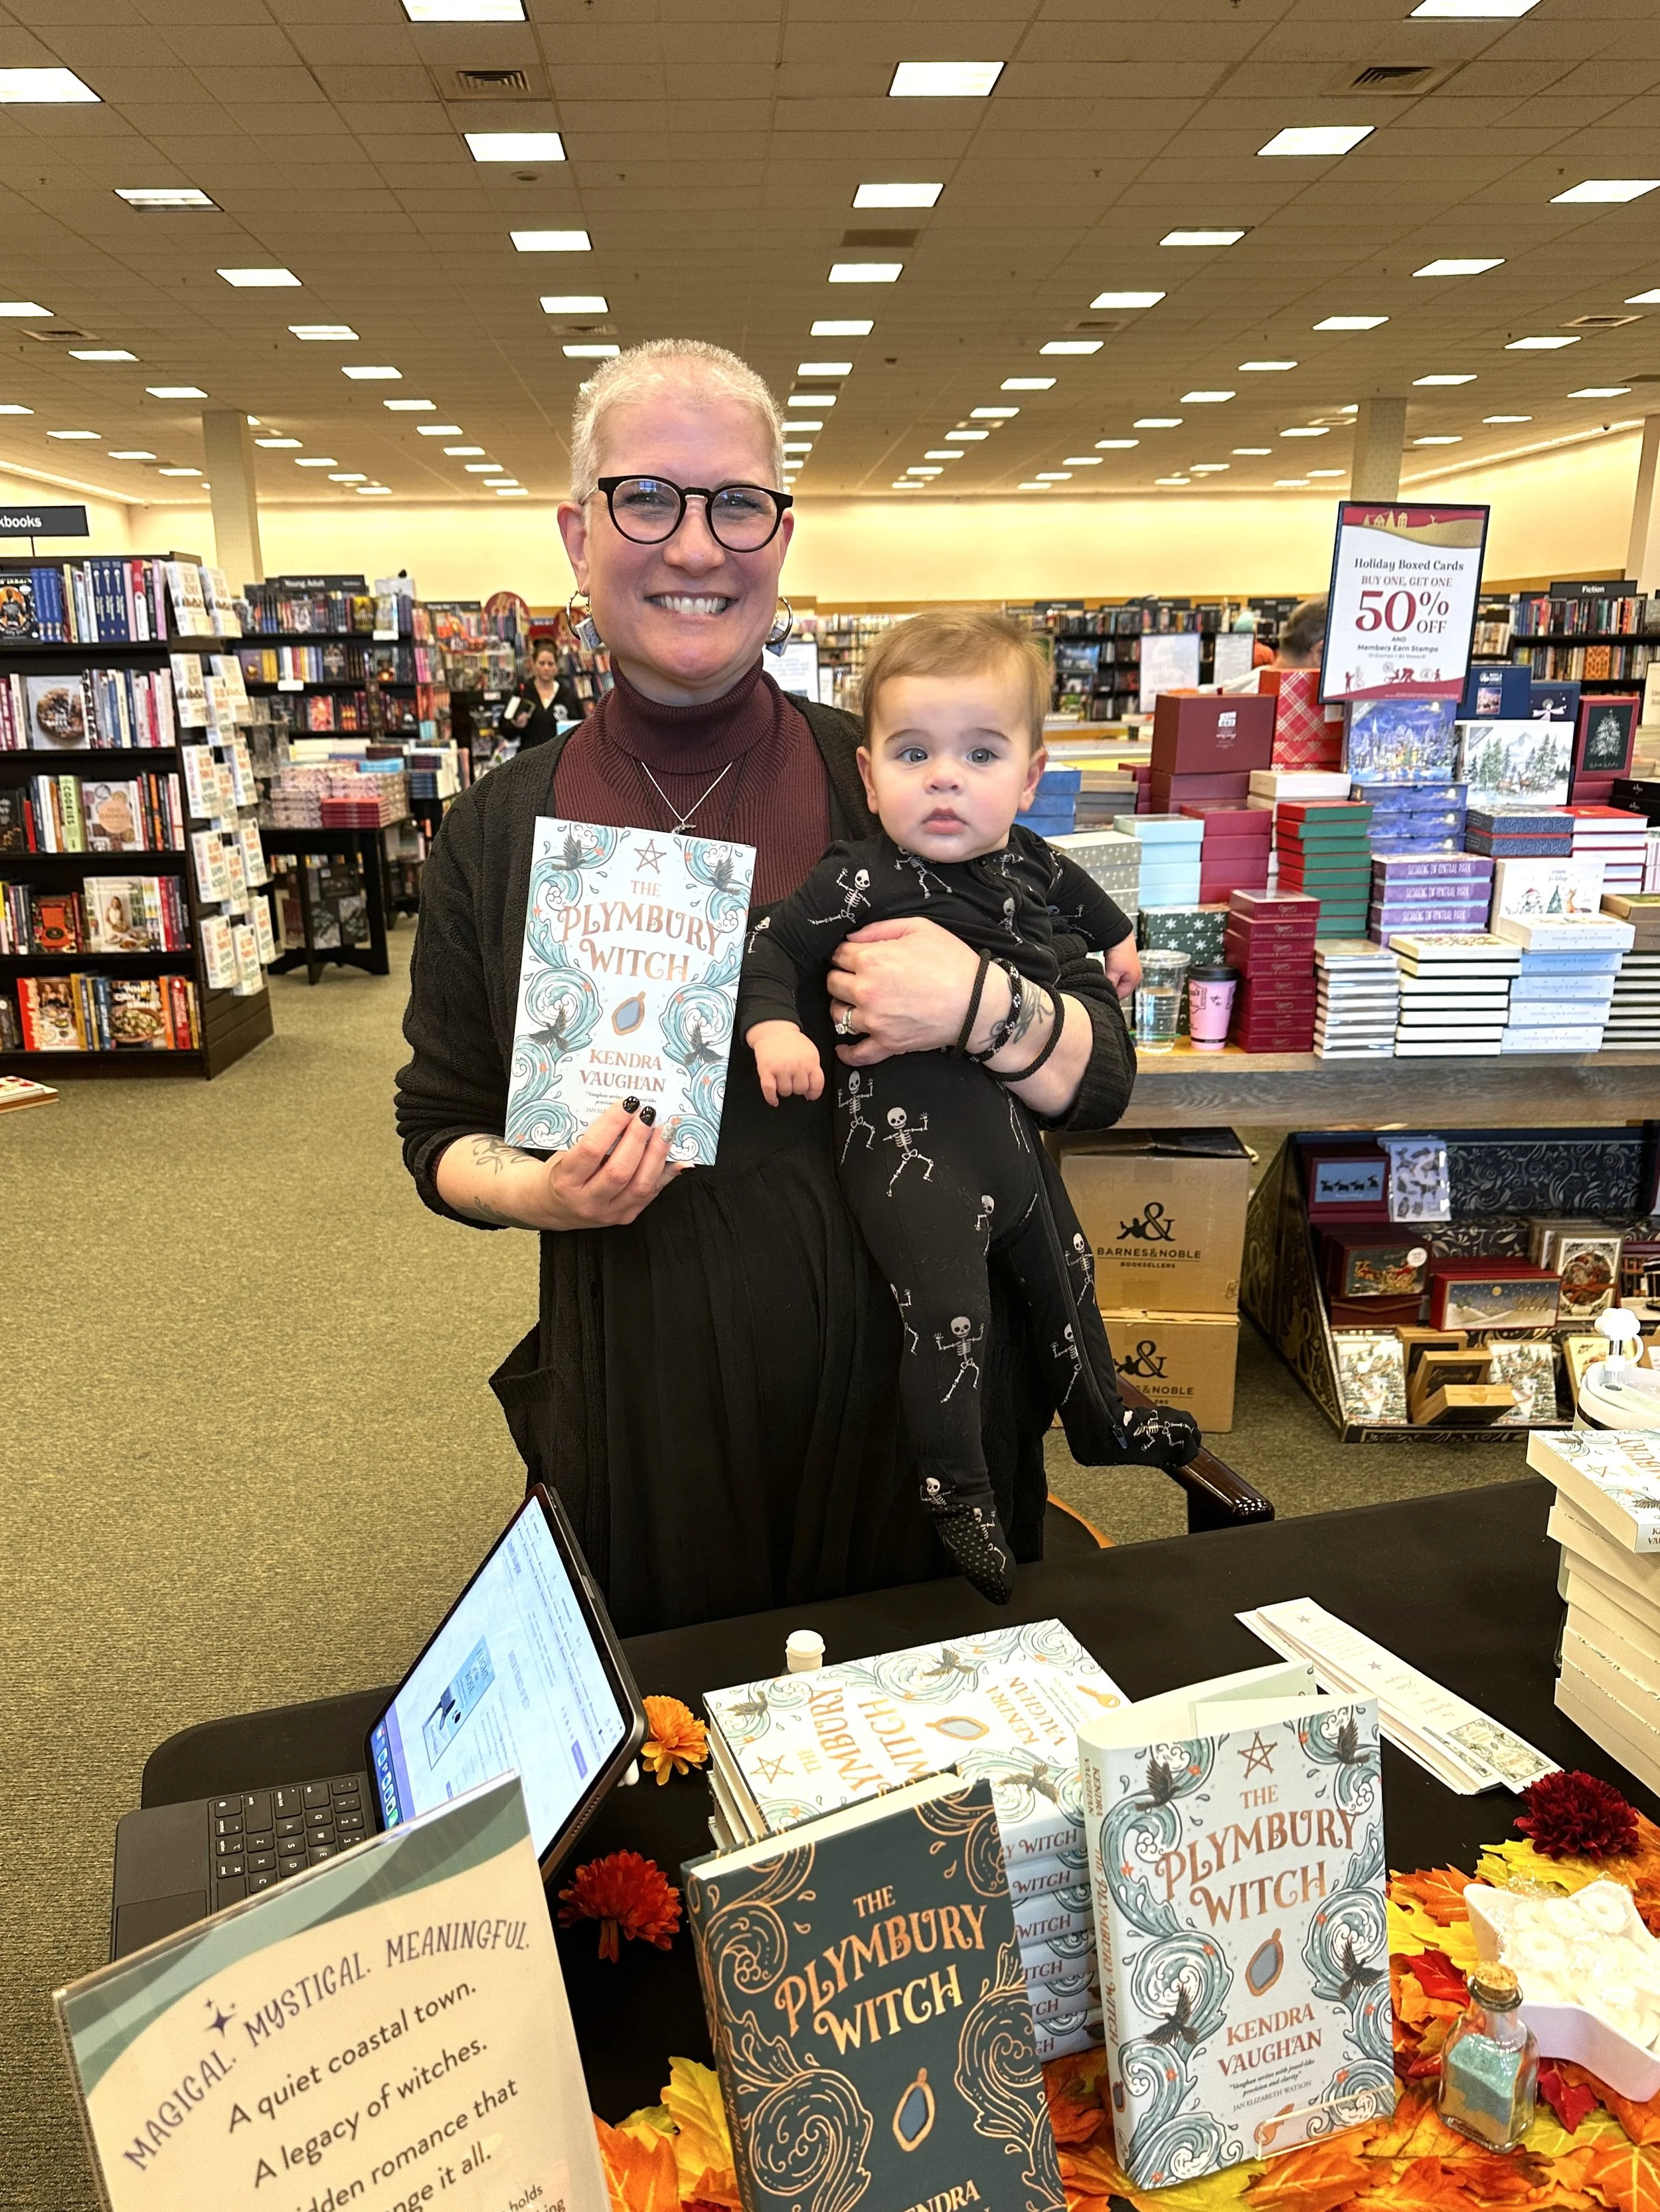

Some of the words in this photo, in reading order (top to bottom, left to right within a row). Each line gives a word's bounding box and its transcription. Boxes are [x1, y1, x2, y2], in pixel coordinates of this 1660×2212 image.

[1355, 558, 1395, 572] Holiday
[1398, 559, 1431, 570] Boxed
[1433, 560, 1464, 570] Cards
[1361, 576, 1382, 585] BUY
[1383, 576, 1407, 587] ONE,
[1409, 577, 1428, 586] GET
[1431, 578, 1452, 587] ONE
[1417, 620, 1448, 634] OFF
[1459, 863, 1471, 873] PARK
[630, 880, 661, 898] THE
[1457, 886, 1469, 896] PARK
[557, 900, 724, 956] PLYMBURY
[1453, 909, 1466, 920] PARK
[578, 938, 691, 982] WITCH
[589, 1049, 663, 1071] KENDRA
[579, 1069, 667, 1093] VAUGHAN
[476, 1648, 490, 1680] FLIGHT
[985, 1685, 1040, 1745] KENDRA
[1005, 1676, 1067, 1746] VAUGHAN
[1083, 1758, 1095, 1816] VAUGHAN
[1092, 1767, 1104, 1818] KENDRA
[1240, 1784, 1279, 1810] THE
[1019, 1828, 1077, 1854] WITCH
[1154, 1808, 1361, 1901] PLYMBURY
[1012, 1870, 1070, 1893] WITCH
[1189, 1860, 1327, 1928] WITCH
[852, 1885, 896, 1918] THE
[1016, 1914, 1071, 1939] WITCH
[774, 1904, 988, 2037] PLYMBURY
[1095, 1879, 1114, 1977] PLYMBURY
[1105, 1981, 1119, 2047] WITCH
[813, 1964, 964, 2055] WITCH
[1225, 2002, 1316, 2047] KENDRA
[124, 2050, 237, 2171] MAGICAL.
[243, 1952, 372, 2048] MYSTICAL.
[386, 1919, 530, 1968] MEANINGFUL.
[229, 2102, 252, 2133] A
[258, 2065, 323, 2120] quiet
[329, 2007, 409, 2073] coastal
[414, 1983, 476, 2023] town.
[1217, 2027, 1324, 2077] VAUGHAN
[1230, 2079, 1256, 2090] "Vaughan
[1258, 2072, 1274, 2081] writes
[1276, 2067, 1287, 2075] with
[1288, 2059, 1315, 2074] jewel-like
[1242, 2084, 1268, 2097] precision
[1268, 2079, 1280, 2087] and
[1280, 2071, 1301, 2084] clarity"
[1233, 2100, 1245, 2113] JAN
[1246, 2088, 1283, 2106] ELIZABETH
[1284, 2080, 1311, 2094] WATSON
[255, 2157, 277, 2188] A
[281, 2111, 359, 2170] legacy
[367, 2083, 390, 2118] of
[397, 2040, 487, 2099] witches.
[371, 2112, 469, 2185] romance
[473, 2079, 518, 2118] that
[438, 2166, 456, 2189] it
[461, 2141, 491, 2175] all.
[509, 2184, 543, 2212] holds
